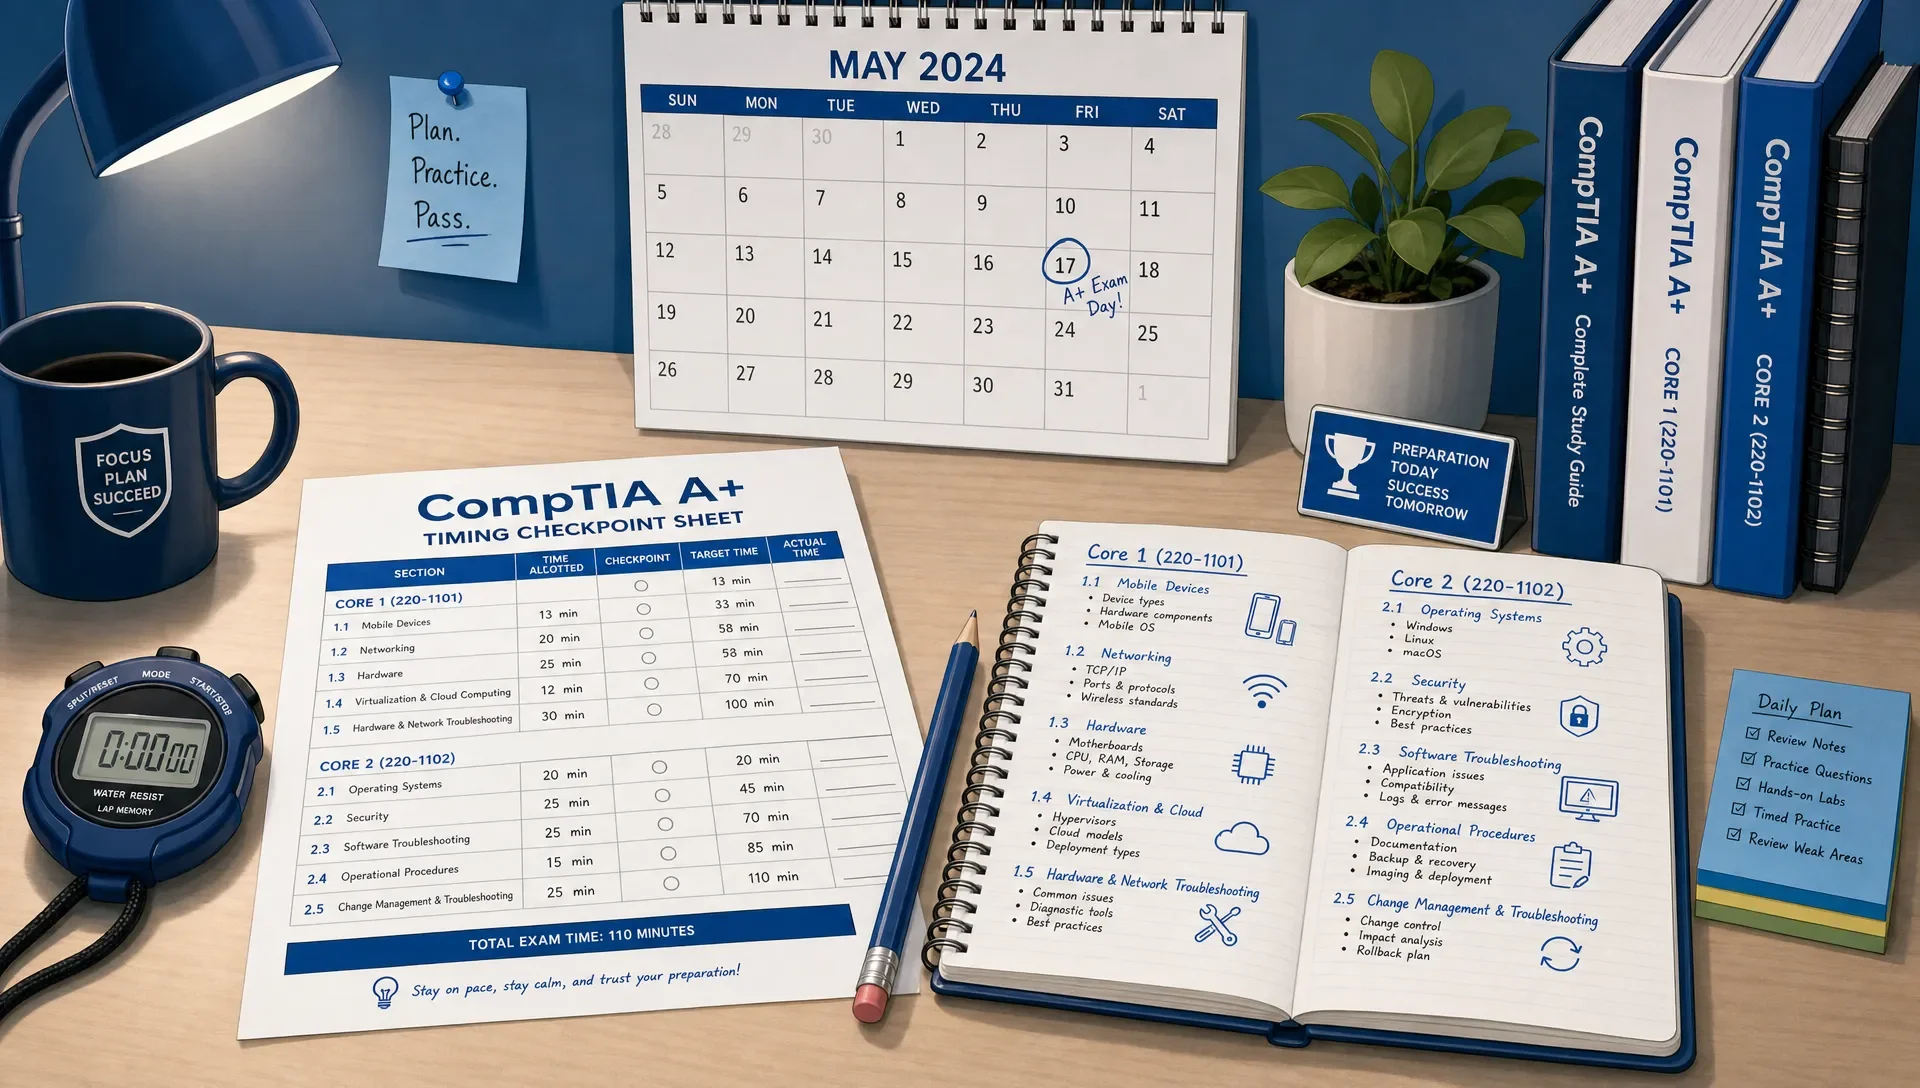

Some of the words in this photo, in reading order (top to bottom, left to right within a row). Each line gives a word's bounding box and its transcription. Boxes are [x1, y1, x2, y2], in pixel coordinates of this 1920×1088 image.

[830, 50, 907, 80] MAY
[919, 51, 1006, 82] 2024
[669, 94, 696, 106] SUN
[746, 96, 777, 109] MON
[827, 99, 855, 112] TUE
[906, 101, 940, 114] WED
[991, 103, 1021, 116] THU
[1076, 105, 1098, 118] FRI
[1159, 107, 1186, 121] SAT
[408, 112, 460, 142] Plan.
[412, 156, 497, 188] Practice.
[1572, 116, 1603, 247] CompTIA
[414, 200, 470, 229] Pass.
[1666, 137, 1699, 268] CompTIA
[1756, 139, 1790, 270] CompTIA
[656, 242, 674, 258] 12
[736, 245, 754, 261] 13
[813, 248, 832, 264] 14
[893, 251, 912, 268] 15
[974, 254, 993, 271] 16
[1056, 257, 1075, 274] 17
[1139, 261, 1159, 278] 18
[1574, 255, 1597, 294] A+
[1064, 287, 1085, 305] A+
[1091, 275, 1128, 294] Exam
[1668, 275, 1691, 314] A+
[1758, 278, 1781, 318] A+
[1086, 292, 1122, 319] Day!
[1570, 315, 1591, 399] Complete
[1664, 348, 1681, 400] CORE
[1754, 354, 1772, 408] CORE
[1567, 406, 1587, 455] Study
[1753, 414, 1768, 426] 2
[97, 448, 151, 467] FOCUS
[1391, 441, 1491, 470] PREPARATION
[1655, 421, 1678, 512] (220-1101)
[105, 468, 147, 486] PLAN
[1391, 460, 1439, 479] TODAY
[1744, 432, 1767, 526] (220-1102)
[94, 485, 161, 505] SUCCEED
[1387, 479, 1449, 500] SUCCESS
[1568, 460, 1585, 507] Guide
[418, 480, 662, 521] CompTIA
[678, 477, 744, 504] A+
[1386, 495, 1468, 521] TOMORROW
[423, 528, 509, 546] TIMING
[517, 516, 666, 539] CHECKPOINT
[674, 511, 743, 528] SHEET
[690, 549, 730, 559] TARGET
[733, 547, 758, 556] TIME
[783, 538, 826, 548] ACTUAL
[792, 548, 820, 557] TIME
[542, 555, 568, 564] TIME
[605, 553, 671, 565] CHECKPOINT
[1088, 543, 1128, 561] Core
[1138, 547, 1146, 563] 1
[1156, 548, 1243, 572] (220-1101)
[394, 567, 445, 578] SECTION
[1392, 569, 1433, 588] Core
[1441, 574, 1453, 590] 2
[1463, 574, 1565, 601] (220-1102)
[335, 598, 373, 609] CORE
[379, 597, 384, 606] 1
[391, 592, 462, 607] (220-1101)
[334, 622, 348, 631] 1.1
[362, 621, 393, 629] Mobile
[397, 619, 431, 628] Devices
[1100, 606, 1148, 618] Hardware
[1154, 613, 1212, 623] components
[331, 647, 347, 657] 1.2
[360, 644, 415, 654] Networking
[1066, 645, 1085, 657] 1.2
[1101, 648, 1172, 667] Networking
[142, 670, 171, 679] MODE
[725, 673, 741, 683] 70
[748, 672, 768, 682] min
[1371, 671, 1392, 683] 2.2
[1412, 674, 1466, 694] Security
[326, 698, 342, 708] 1.4
[355, 695, 417, 706] Virtualization
[420, 693, 427, 702] &
[430, 691, 457, 701] Cloud
[460, 688, 511, 700] Computing
[541, 685, 555, 695] 12
[563, 684, 583, 694] min
[1081, 692, 1123, 704] Wireless
[1129, 697, 1178, 708] standards
[1392, 691, 1434, 704] Threats
[1439, 695, 1447, 705] &
[1453, 697, 1531, 712] vulnerabilities
[1758, 693, 1798, 721] Daily
[1810, 701, 1842, 720] Plan
[324, 725, 340, 735] 1.5
[353, 723, 395, 732] Hardware
[397, 721, 405, 729] &
[408, 719, 444, 728] Network
[446, 715, 512, 726] Troubleshooting
[1768, 729, 1807, 746] Review
[1812, 737, 1846, 753] Notes
[320, 759, 360, 772] CORE
[365, 758, 373, 769] 2
[380, 752, 455, 769] (220-1102)
[1066, 751, 1092, 764] CPU,
[1098, 753, 1128, 767] RAM,
[1134, 756, 1174, 772] Storage
[1763, 755, 1809, 774] Practice
[1815, 764, 1872, 785] Questions
[94, 789, 126, 798] WATER
[130, 791, 164, 801] RESIST
[1381, 778, 1455, 796] Compatibility
[1758, 781, 1813, 801] Hands-on
[1819, 791, 1845, 806] Labs
[116, 806, 153, 816] MEMORY
[314, 814, 332, 826] 2.2
[346, 812, 389, 823] Security
[1052, 811, 1116, 827] Hypervisors
[1754, 806, 1789, 823] Timed
[1795, 813, 1841, 833] Practice
[1346, 815, 1368, 828] 2.4
[1387, 818, 1462, 835] Operational
[1470, 824, 1535, 842] Procedures
[311, 843, 329, 855] 2.3
[344, 841, 389, 852] Software
[392, 835, 470, 848] Troubleshooting
[1371, 836, 1457, 853] Documentation
[1749, 832, 1788, 850] Review
[1795, 841, 1825, 858] Weak
[1829, 848, 1863, 865] Areas
[307, 873, 327, 885] 2.4
[341, 868, 400, 883] Operational
[404, 865, 459, 876] Procedures
[469, 937, 514, 950] TOTAL
[520, 934, 560, 947] EXAM
[565, 931, 603, 944] TIME:
[609, 929, 632, 941] 110
[637, 925, 695, 939] MINUTES
[412, 985, 440, 1001] Stay
[464, 984, 496, 998] pace,
[503, 980, 529, 995] stay
[534, 977, 566, 990] calm,
[572, 974, 595, 986] and
[600, 972, 631, 985] trust
[636, 973, 663, 987] your
[668, 963, 741, 984] preparation!
